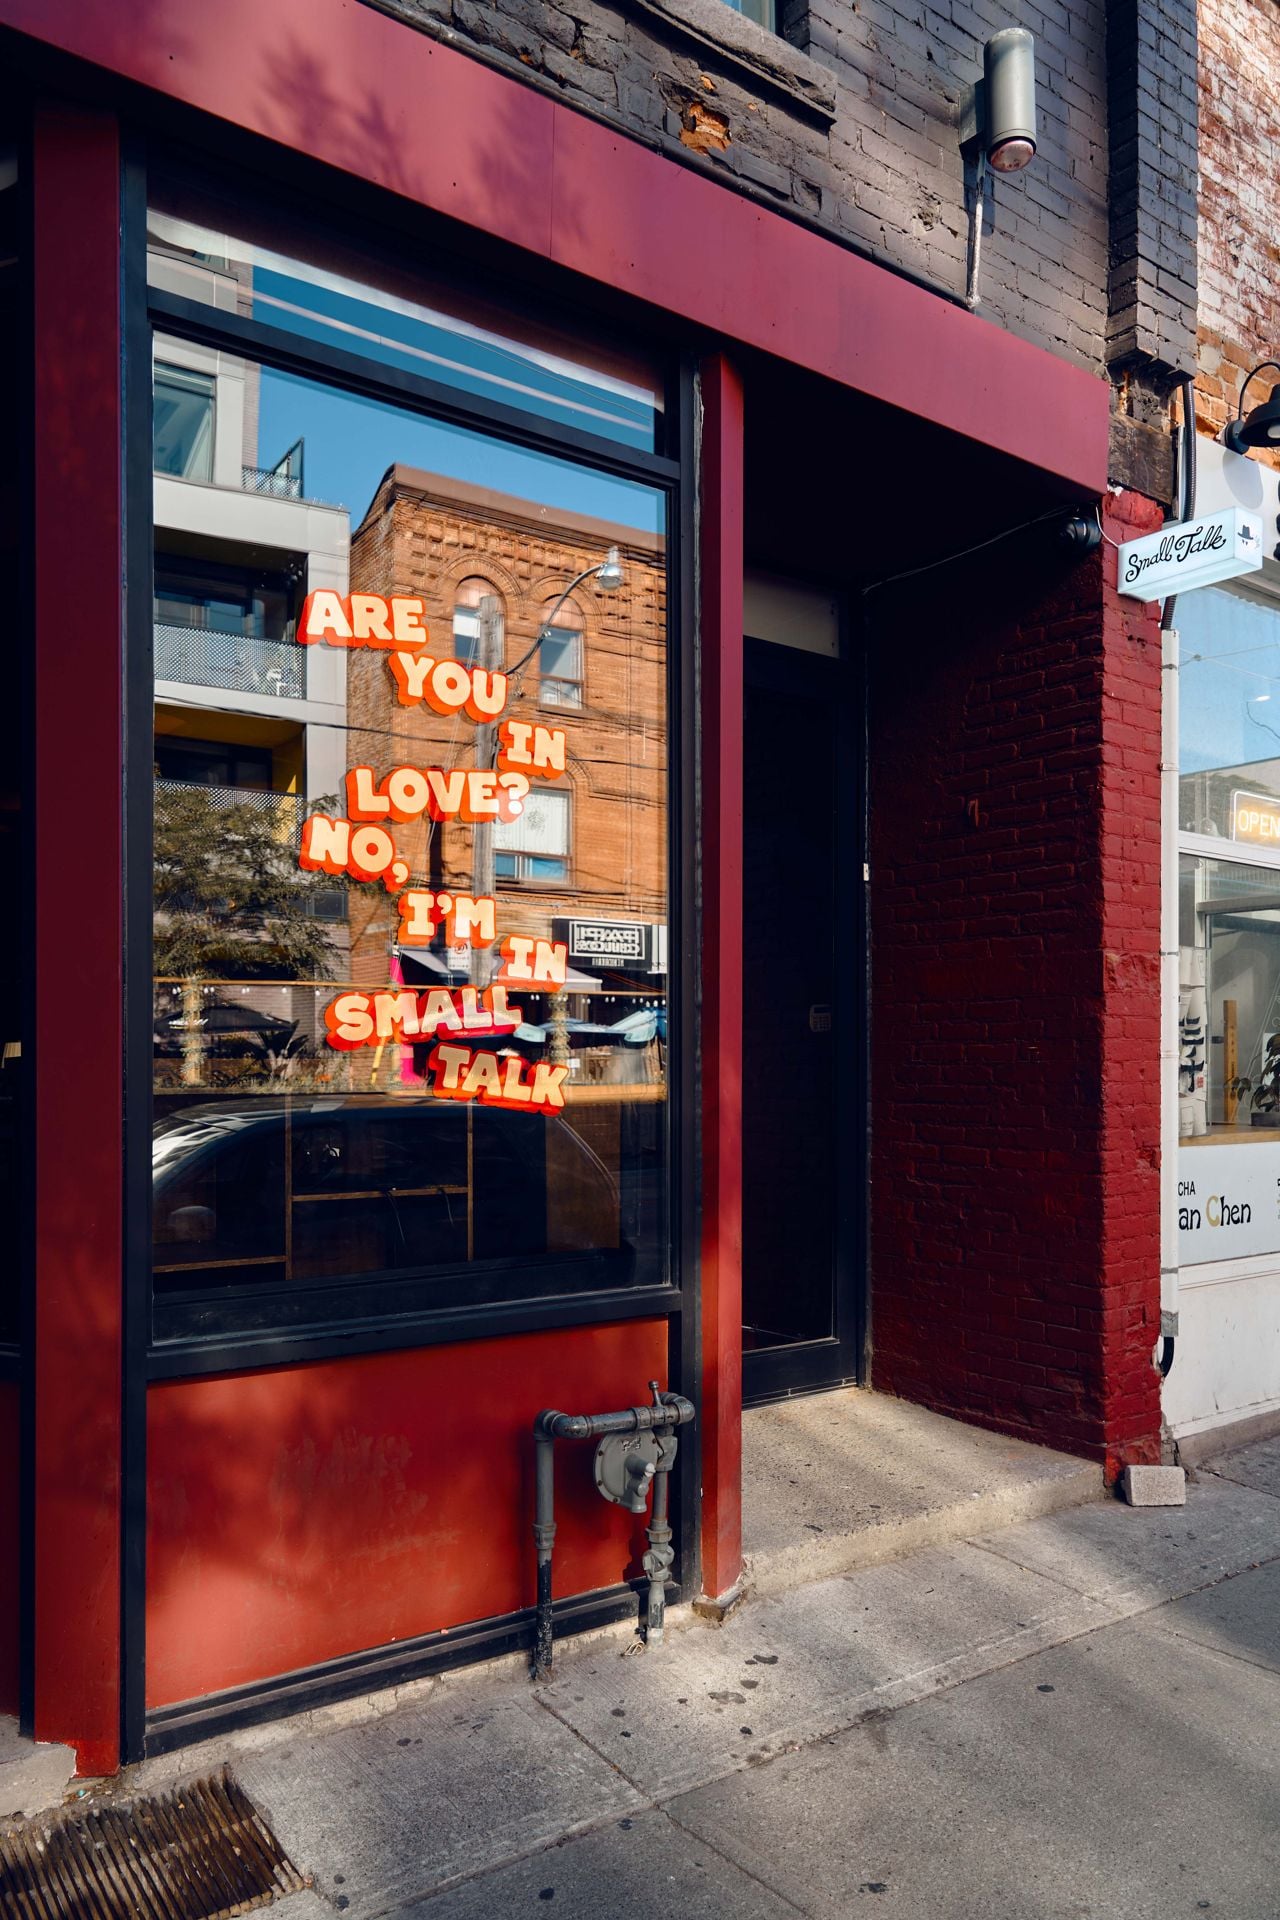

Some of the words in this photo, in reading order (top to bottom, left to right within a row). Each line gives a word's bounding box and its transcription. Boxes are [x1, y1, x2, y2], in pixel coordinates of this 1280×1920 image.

[1125, 535, 1174, 583] Small
[1175, 525, 1227, 562] Talk
[300, 589, 428, 648] ARE
[392, 651, 508, 719] YOU
[501, 719, 566, 776] IN
[350, 767, 530, 820] LOVE?
[303, 814, 410, 887] NO,
[1238, 809, 1280, 838] OPEN
[402, 891, 496, 944] I'M
[502, 935, 567, 988] IN
[329, 984, 523, 1046] SMALL
[433, 1043, 569, 1112] TALK
[1206, 1195, 1251, 1227] Chen
